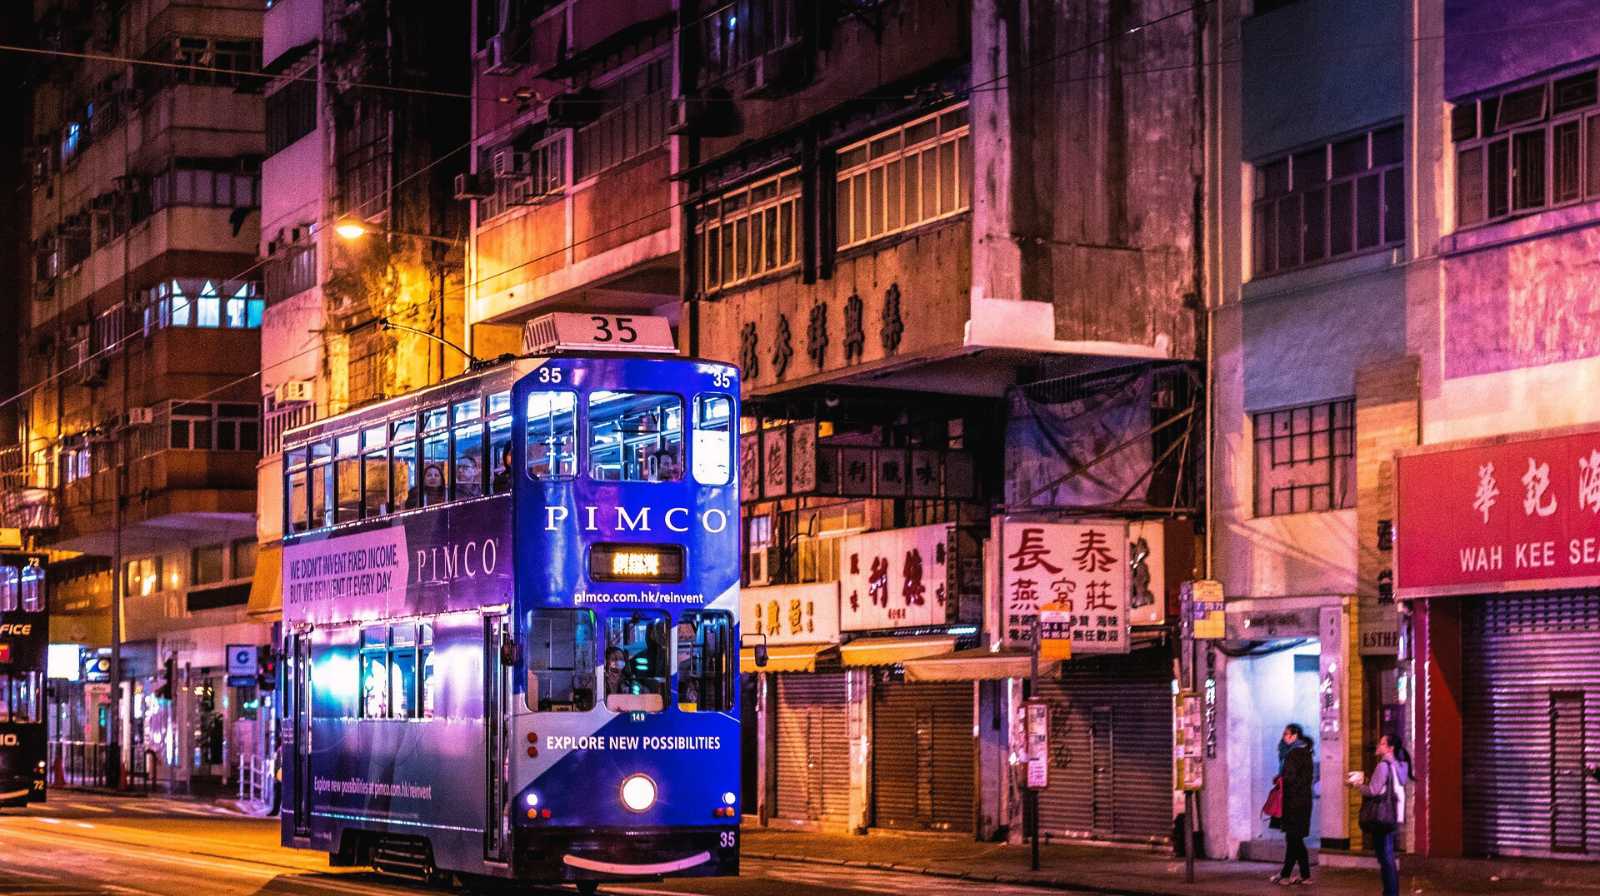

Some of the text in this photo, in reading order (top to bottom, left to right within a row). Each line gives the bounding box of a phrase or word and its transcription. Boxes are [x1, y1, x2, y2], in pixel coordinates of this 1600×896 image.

[591, 316, 638, 343] 35
[539, 367, 562, 383] 35
[713, 372, 731, 388] 35
[544, 506, 727, 533] PIMCO
[291, 560, 300, 579] WE
[323, 552, 347, 575] INVENT
[348, 549, 367, 571] FIXED
[368, 544, 399, 568] INCOME,
[417, 538, 497, 582] PIMCO
[1008, 528, 1118, 574] 長泰
[1460, 545, 1503, 572] WAH
[1516, 541, 1556, 569] KEE
[28, 557, 40, 567] 72
[303, 581, 313, 602] WE
[346, 576, 353, 597] IT
[354, 573, 375, 596] EVERY
[574, 591, 704, 605] pimco.com.hk/reinvent
[546, 736, 721, 750] EXPLORE NEW POSSIBILITIES
[33, 779, 44, 791] 72
[720, 832, 735, 848] 35
